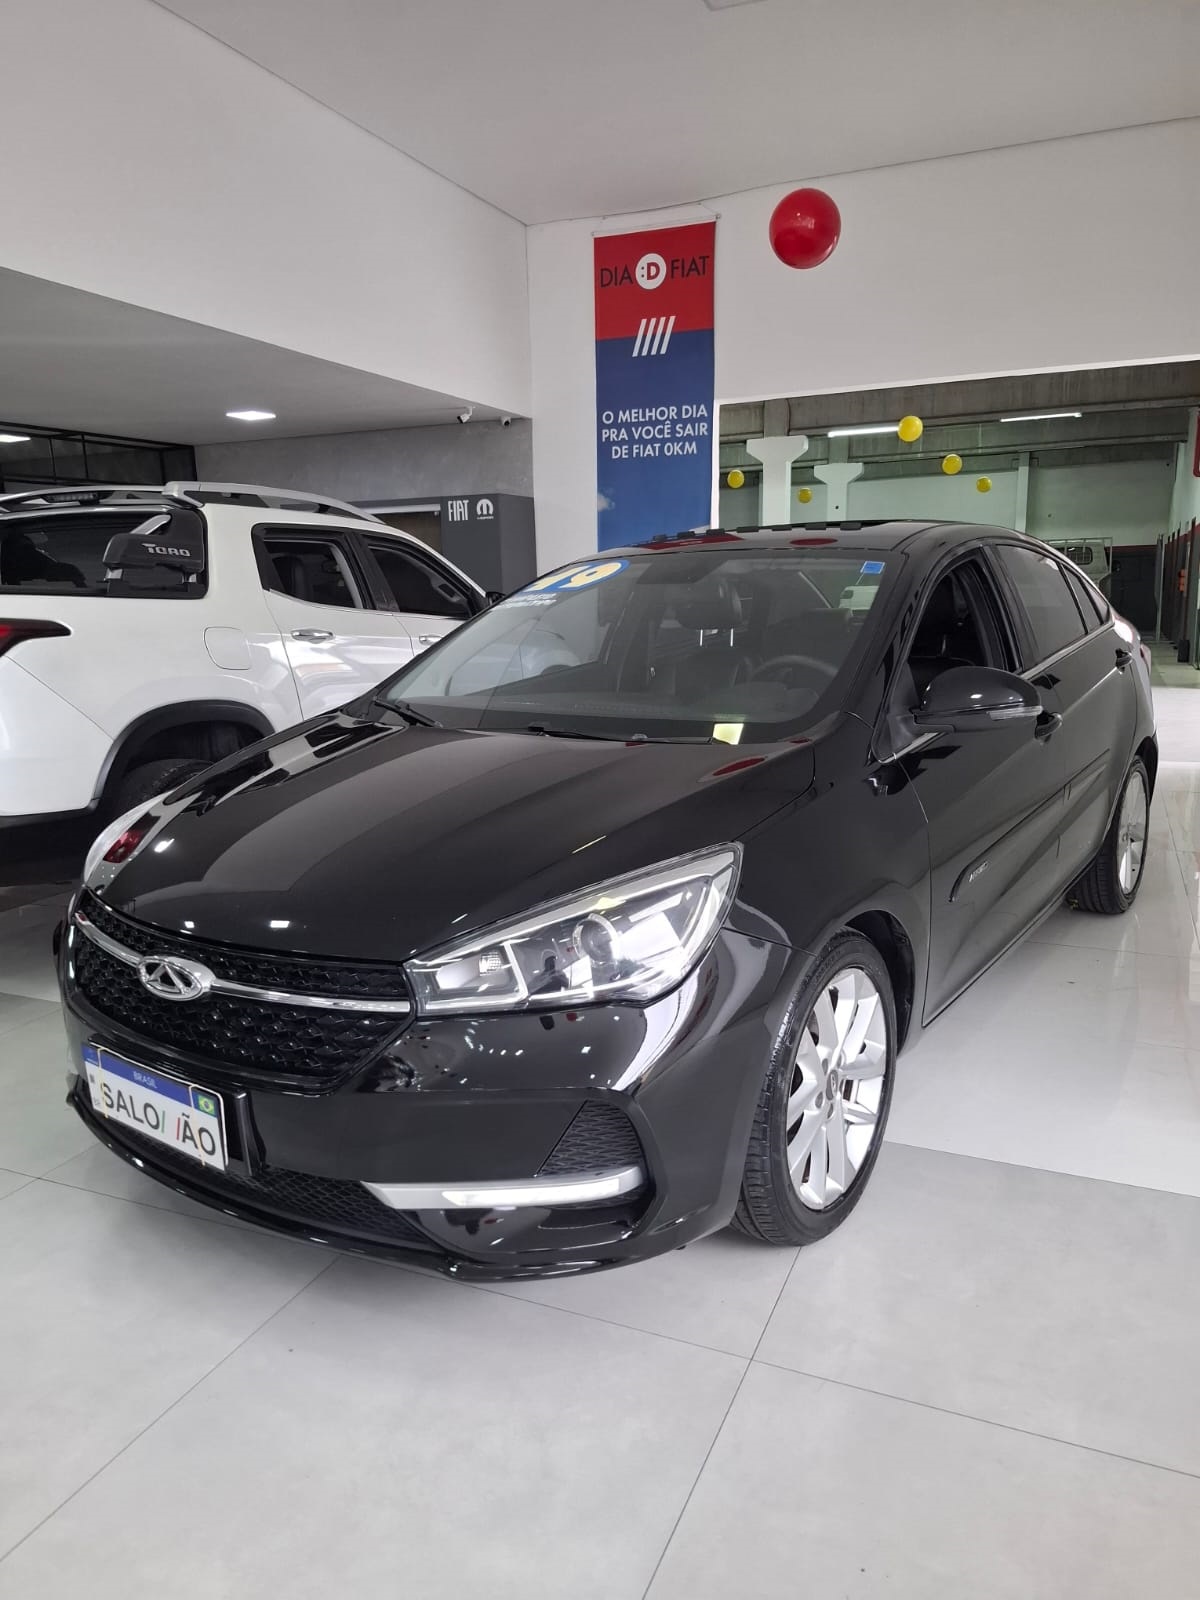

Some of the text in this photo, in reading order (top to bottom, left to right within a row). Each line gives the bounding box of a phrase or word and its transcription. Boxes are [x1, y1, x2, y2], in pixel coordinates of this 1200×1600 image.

[600, 264, 633, 288] DIA
[671, 255, 710, 279] FIAT
[602, 404, 708, 424] O MELHOR DIA
[602, 420, 708, 442] PRA VOCÊ SAIR
[612, 446, 629, 459] DE
[633, 443, 661, 458] FIAT
[448, 500, 469, 521] FIAT
[142, 543, 190, 557] TORO
[133, 1071, 157, 1089] BRASIL
